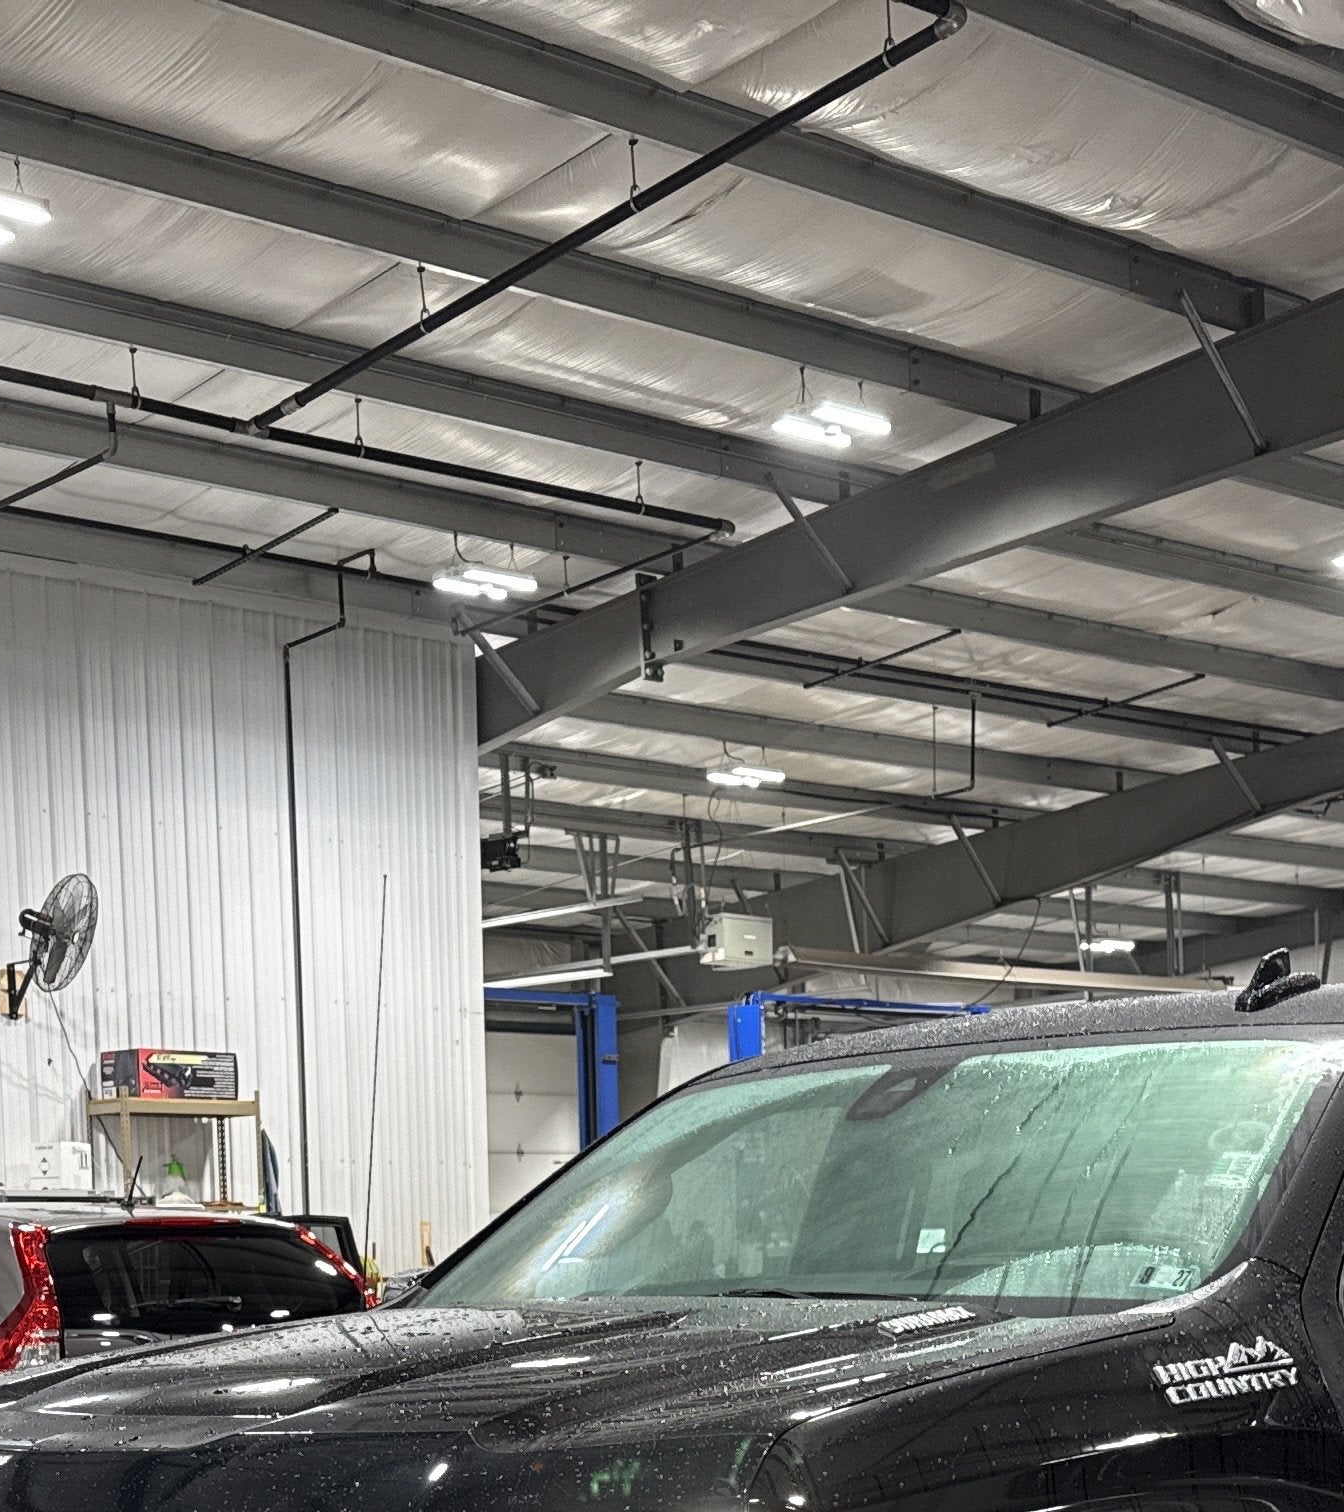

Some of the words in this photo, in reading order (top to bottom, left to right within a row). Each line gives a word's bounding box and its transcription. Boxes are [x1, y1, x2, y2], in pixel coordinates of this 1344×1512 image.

[1172, 1269, 1192, 1287] 27
[1153, 1355, 1229, 1385] HIGH
[1165, 1366, 1299, 1405] COUNTRY
